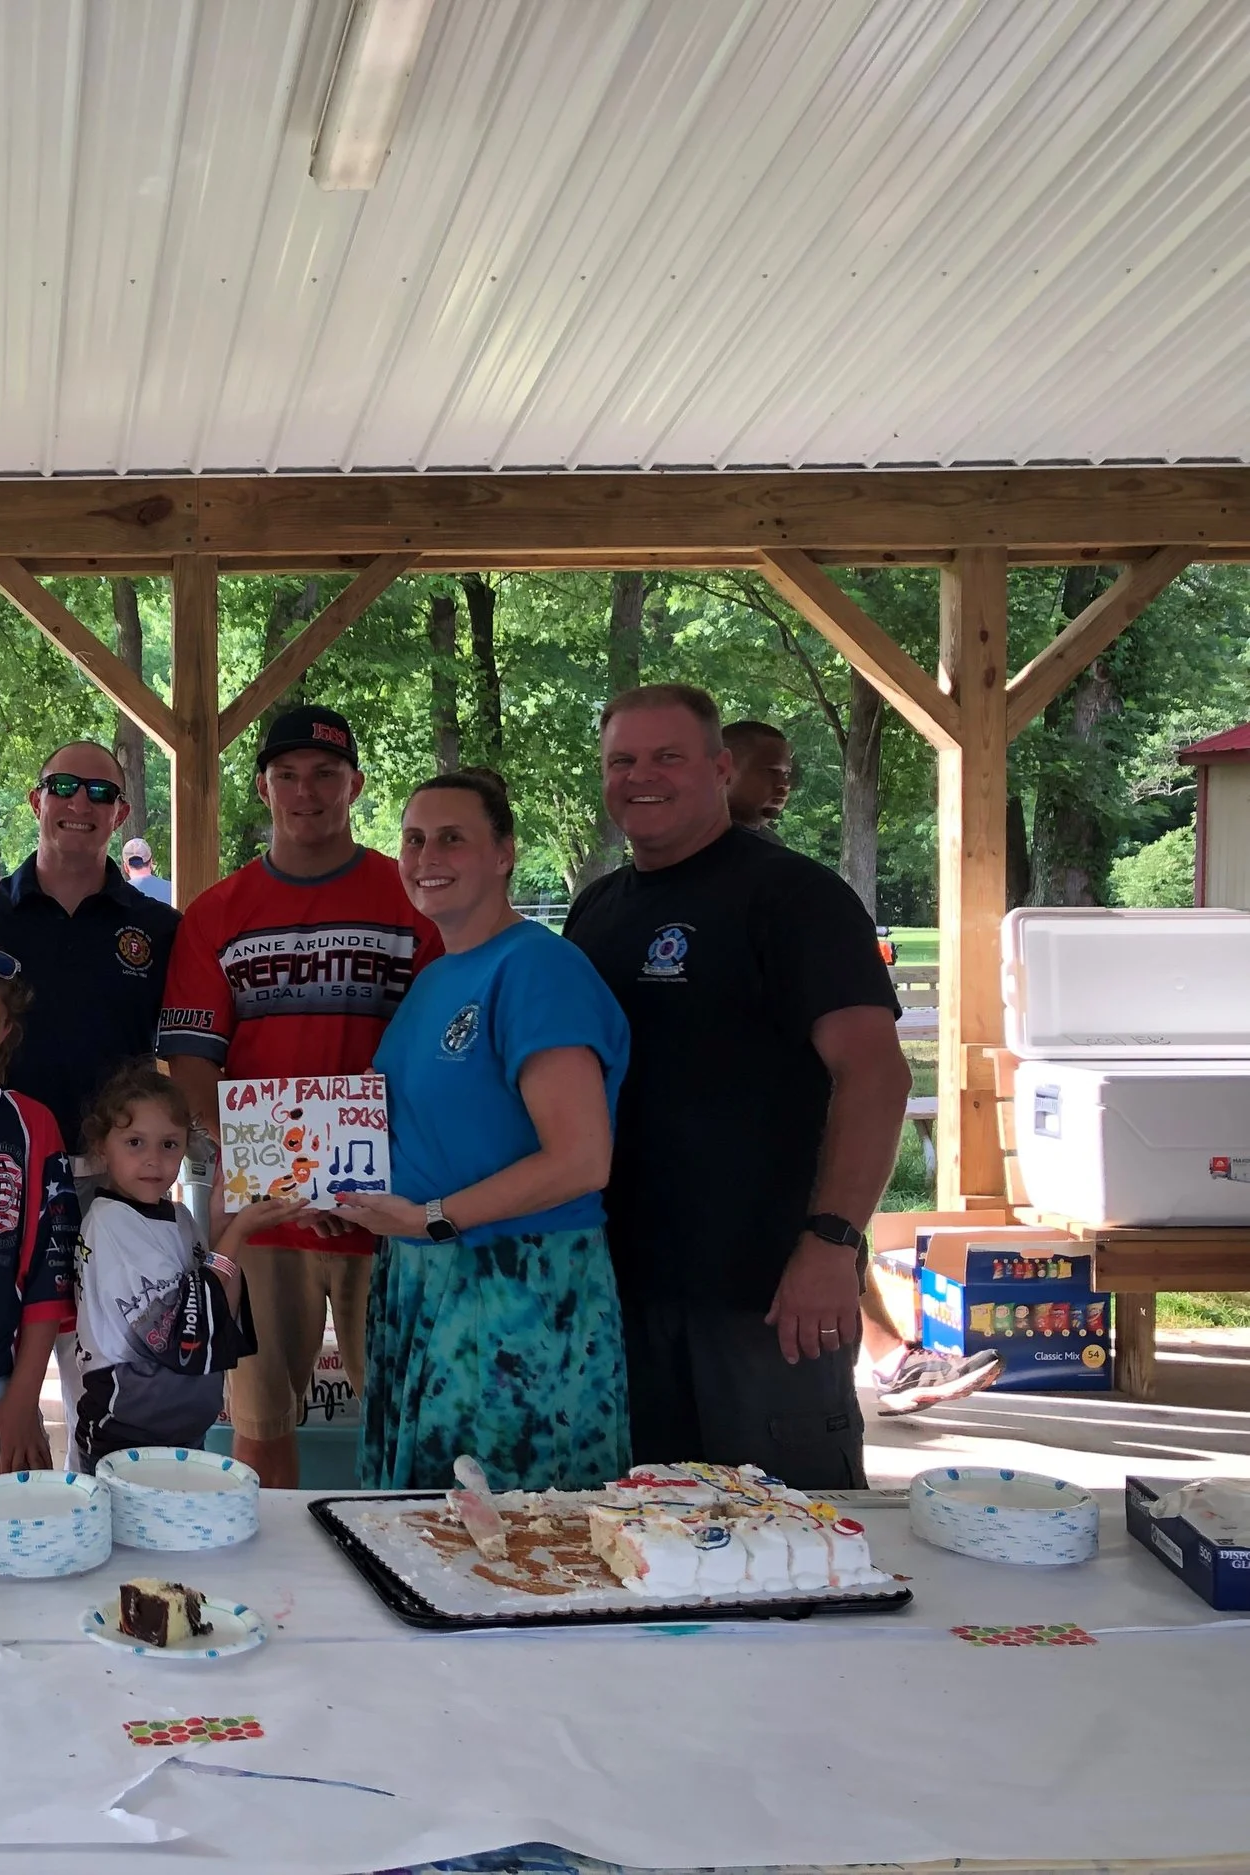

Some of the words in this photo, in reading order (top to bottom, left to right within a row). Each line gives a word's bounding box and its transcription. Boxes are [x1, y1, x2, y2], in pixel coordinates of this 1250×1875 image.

[232, 940, 285, 959] ANNE
[293, 936, 387, 952] ARUNDEL
[246, 987, 306, 1003] OCAL
[318, 985, 373, 998] 1563
[225, 1078, 289, 1111] CAMP
[295, 1076, 385, 1104] FAIRLEE
[338, 1106, 388, 1133] ROCKS!
[222, 1119, 285, 1146] DREAM
[233, 1144, 286, 1170] BIG!
[1034, 1352, 1063, 1361] Classic
[1065, 1351, 1080, 1360] Mix
[1088, 1350, 1099, 1358] 54
[1232, 1560, 1250, 1569] GL
